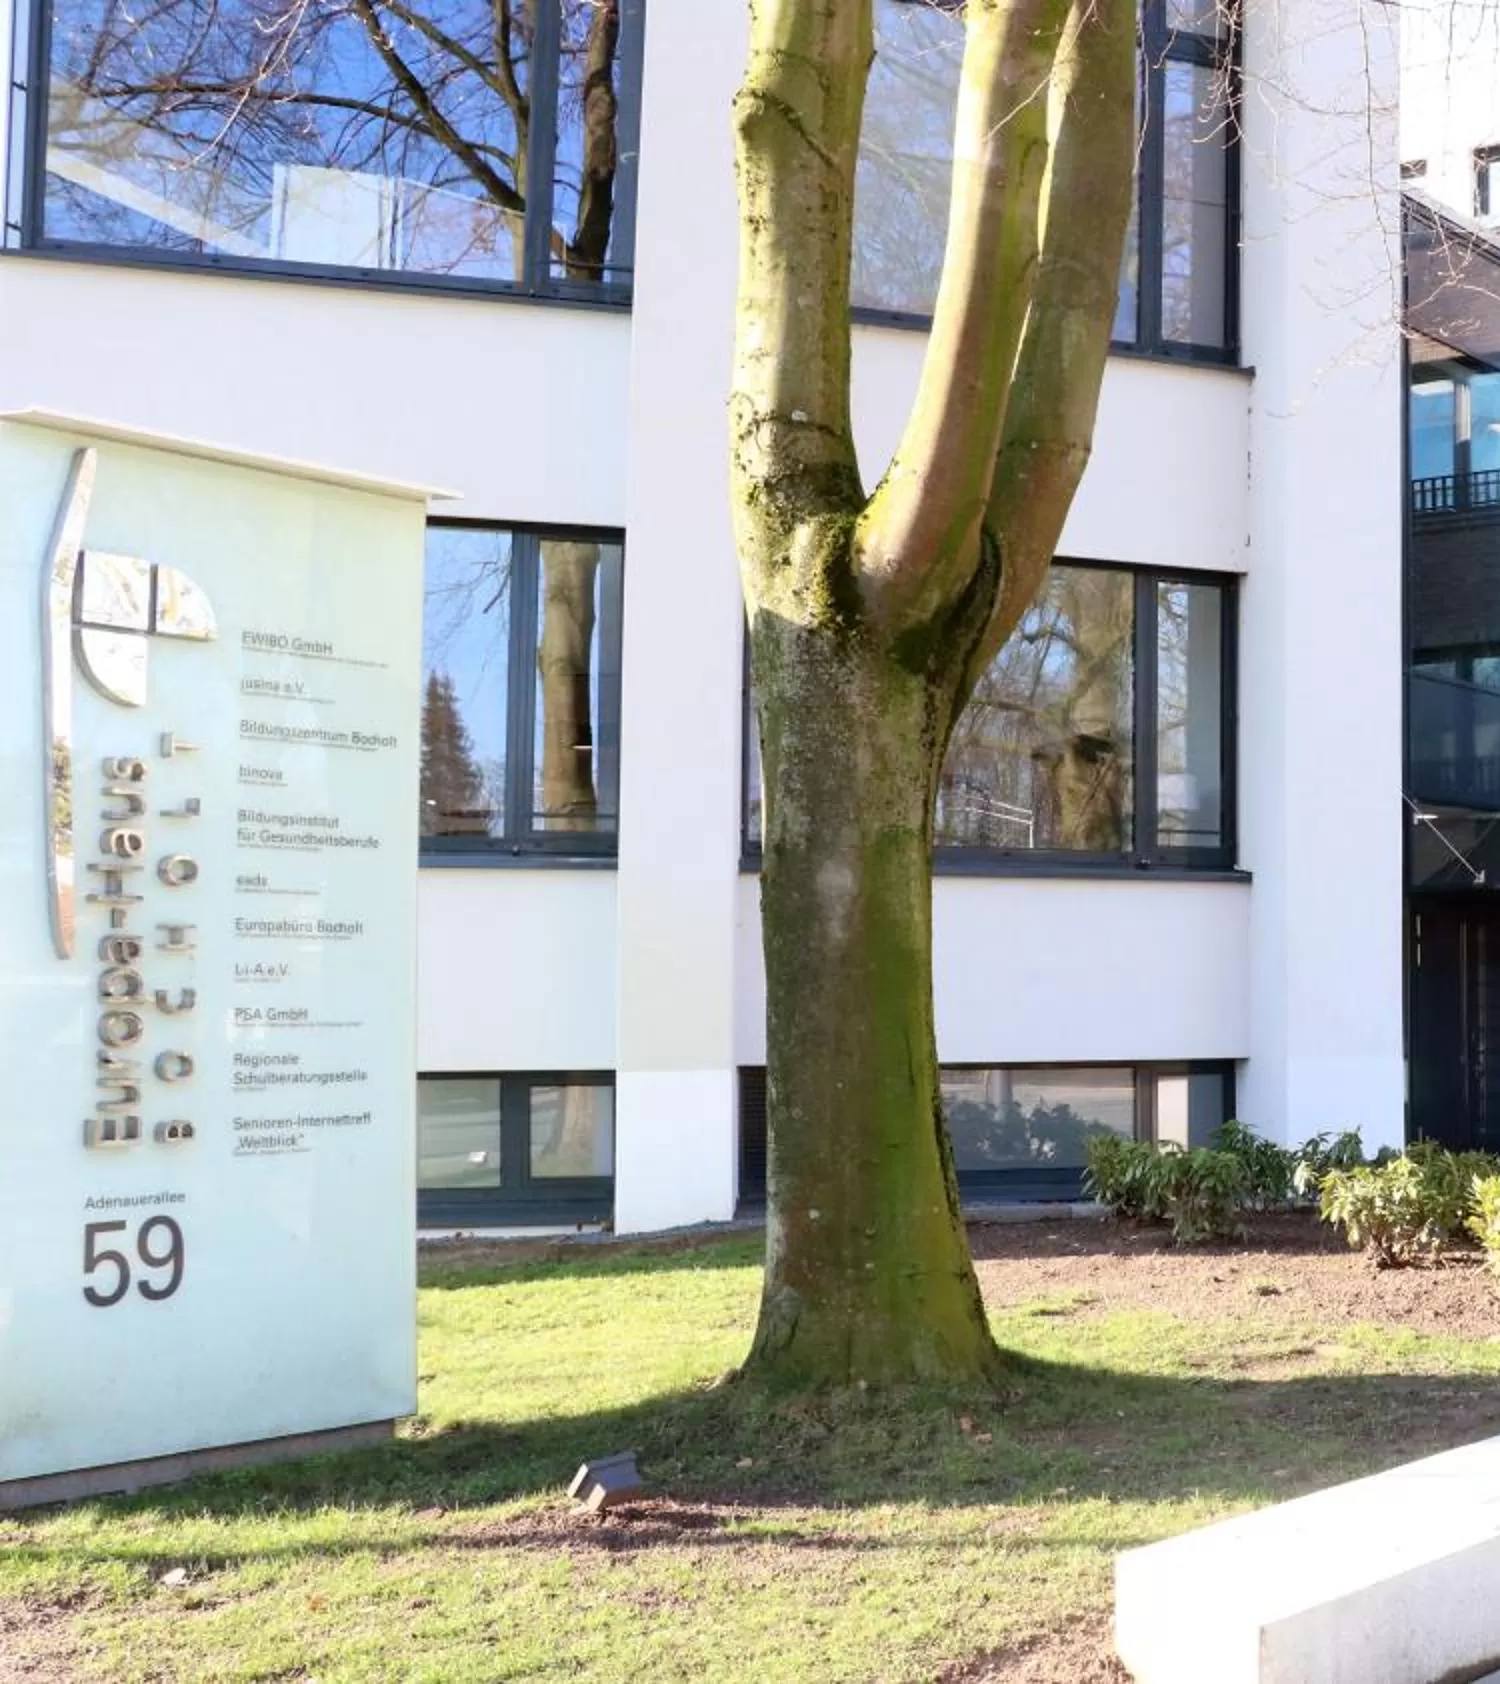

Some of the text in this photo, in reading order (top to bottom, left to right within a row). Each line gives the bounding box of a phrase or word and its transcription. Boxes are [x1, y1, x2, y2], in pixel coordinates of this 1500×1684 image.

[242, 631, 333, 655] EWIBO GmbH
[240, 719, 348, 742] Bildungszentrum
[351, 731, 397, 748] Bocholt
[237, 808, 340, 829] Bildungsinstitut
[237, 827, 256, 842] für
[259, 829, 381, 849] Gesundheitsberufe
[235, 917, 364, 936] Europabüro Bocholt
[84, 756, 147, 1150] Europa-Haus
[234, 1008, 309, 1021] PSA GmbH
[234, 1053, 300, 1068] Regionale
[233, 1070, 368, 1086] Schulberatungsstelle
[233, 1112, 372, 1130] Senioren-Internettreff
[84, 1191, 186, 1209] Adenauerallee
[83, 1214, 185, 1308] 59
